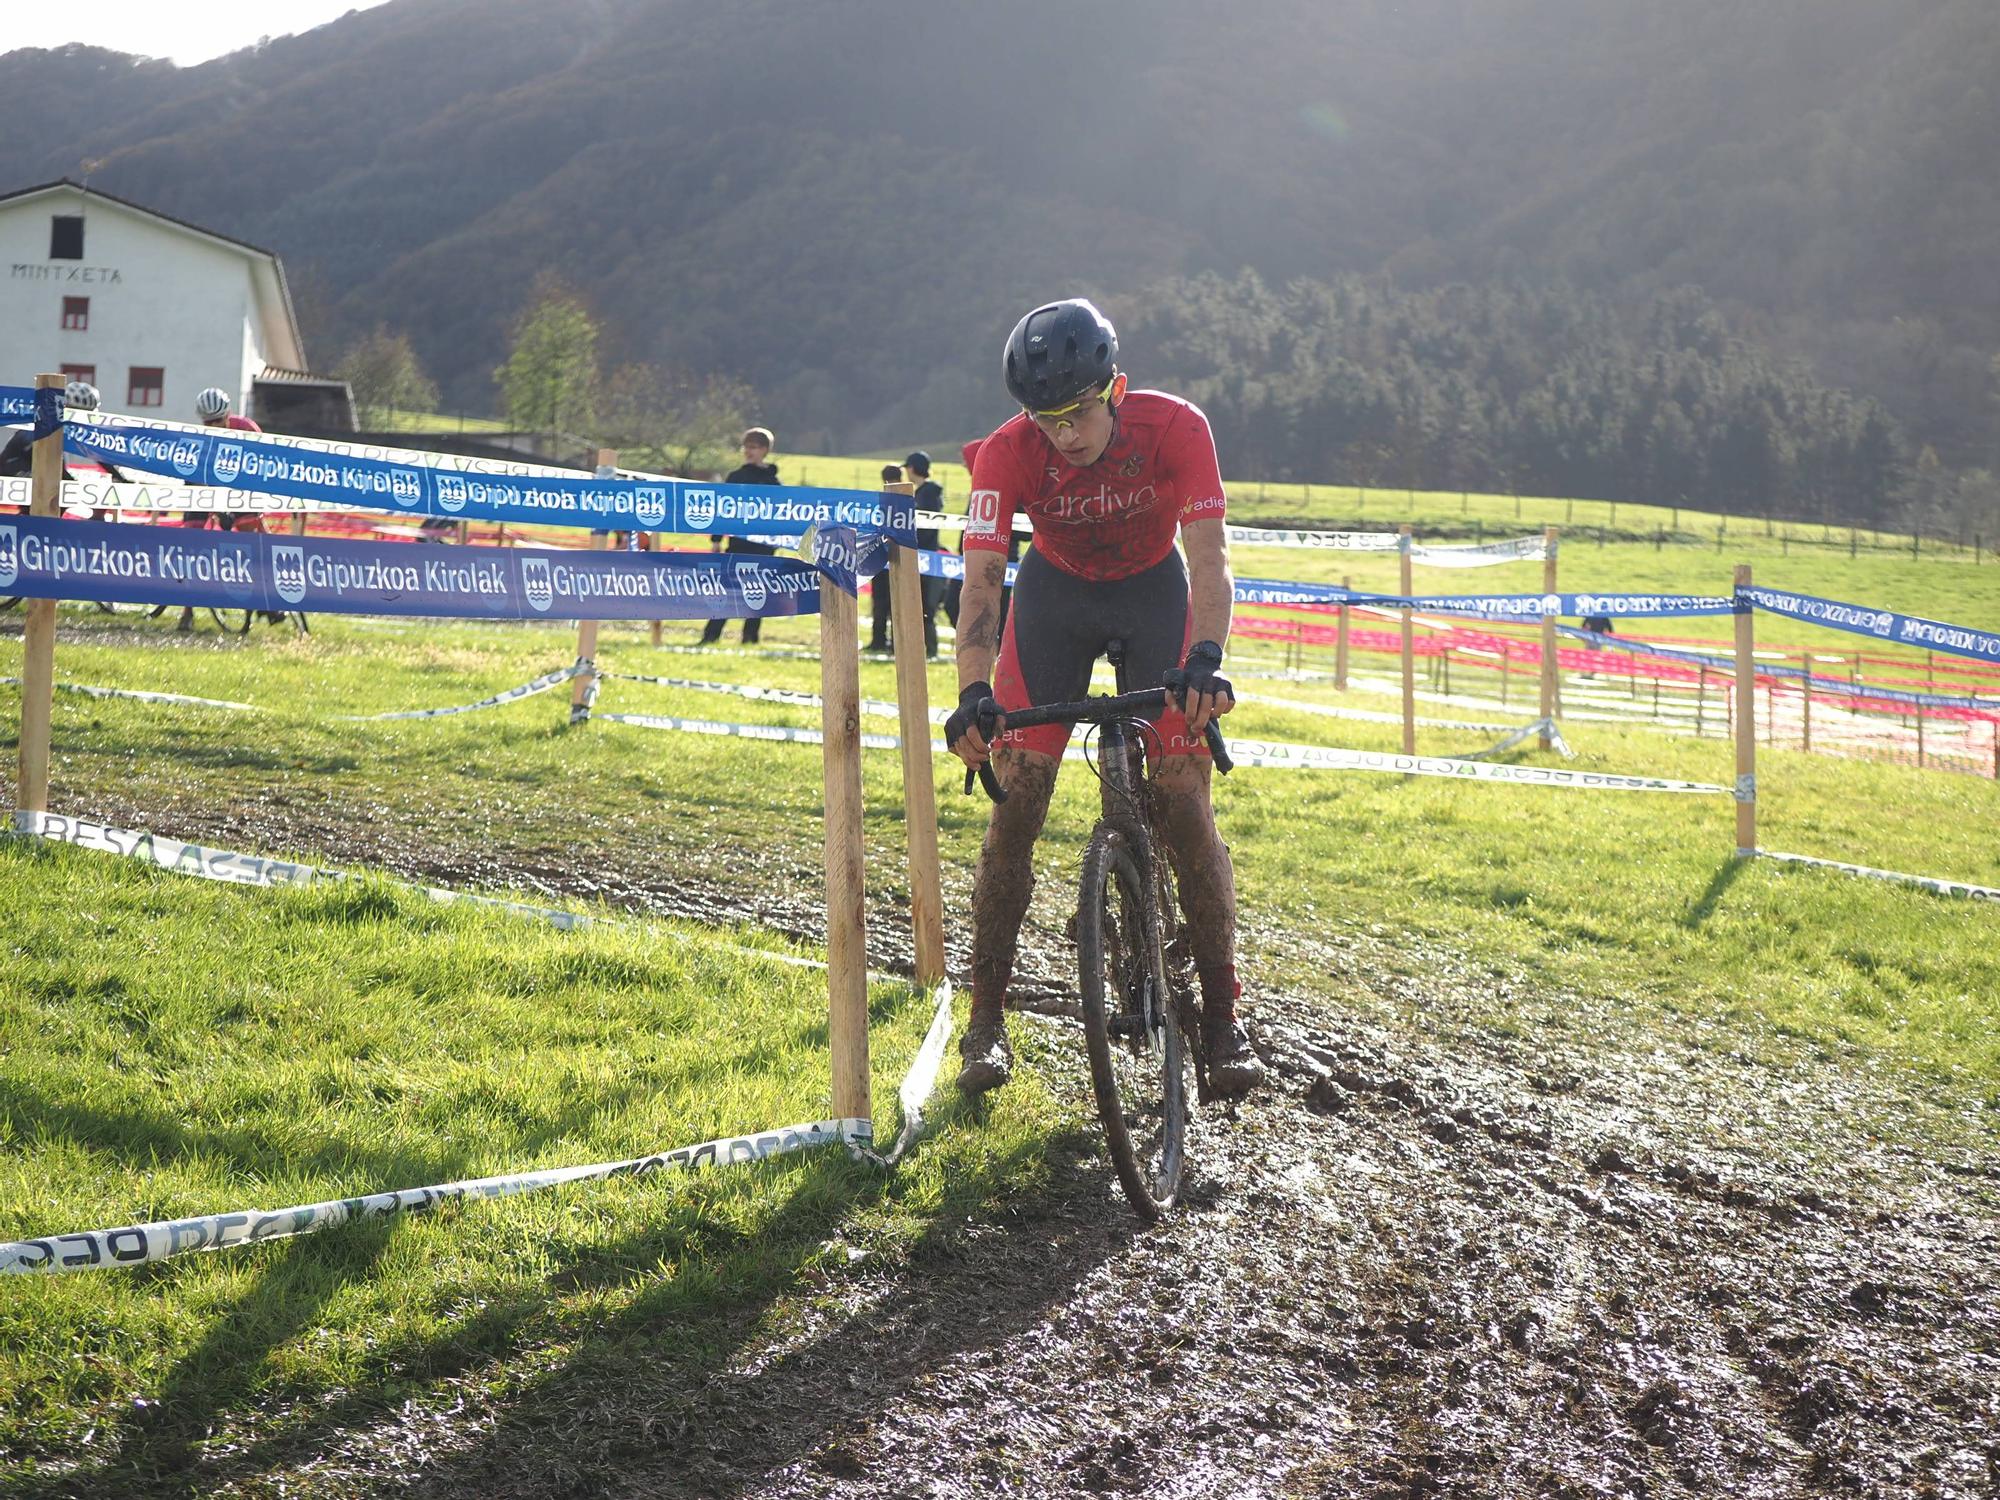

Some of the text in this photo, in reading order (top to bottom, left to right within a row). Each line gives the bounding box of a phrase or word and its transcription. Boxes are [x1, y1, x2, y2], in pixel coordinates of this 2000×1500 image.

[10, 264, 122, 283] MINTXETA
[62, 483, 121, 507] ESA
[242, 450, 339, 487] Gipuzkoa
[468, 481, 577, 510] Gipuzkoa
[718, 494, 830, 524] Gipuzkoa
[837, 500, 917, 530] Kirolak
[972, 493, 998, 522] 10
[21, 535, 821, 602] Gipuzkoa Kirolak Gipuzkoa Kirolak Gipuzkoa Kirolak Gipuz
